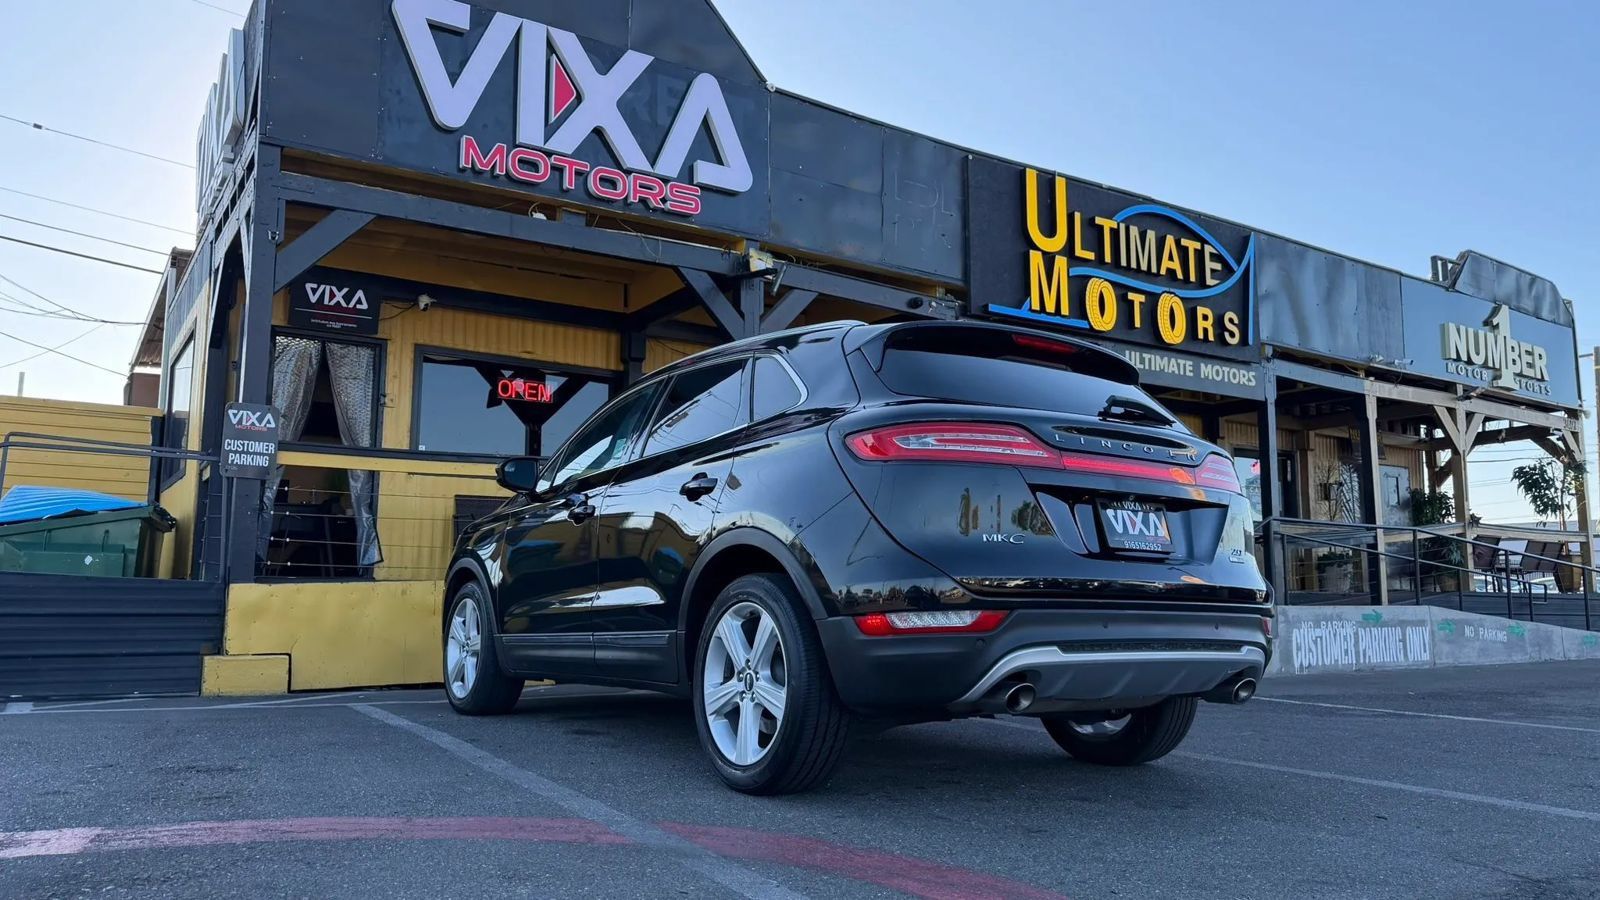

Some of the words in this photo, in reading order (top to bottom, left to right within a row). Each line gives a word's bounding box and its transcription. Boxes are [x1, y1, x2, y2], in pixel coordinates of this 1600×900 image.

[391, 0, 753, 192] VIXA
[459, 135, 701, 215] MOTORS
[1023, 167, 1223, 286] ULTIMATE
[305, 283, 368, 310] VIXA
[1028, 249, 1240, 345] MOTORS
[1442, 322, 1549, 380] NUMBER
[1125, 350, 1194, 376] ULTIMATE
[1200, 363, 1256, 387] MOTORS
[1446, 362, 1488, 381] MOTOR
[1513, 375, 1552, 396] SPORTS
[498, 379, 552, 402] OPEN
[228, 409, 276, 428] VIXA
[224, 438, 275, 454] CUSTOMER
[228, 453, 270, 467] PARKING
[1106, 508, 1165, 537] VIXA
[982, 533, 1026, 545] MKC
[1292, 627, 1356, 670] CUSTOMER
[1358, 626, 1404, 664] PARKING
[1406, 626, 1430, 661] ONLY
[1464, 624, 1475, 639] NO
[1480, 627, 1508, 643] PARKING
